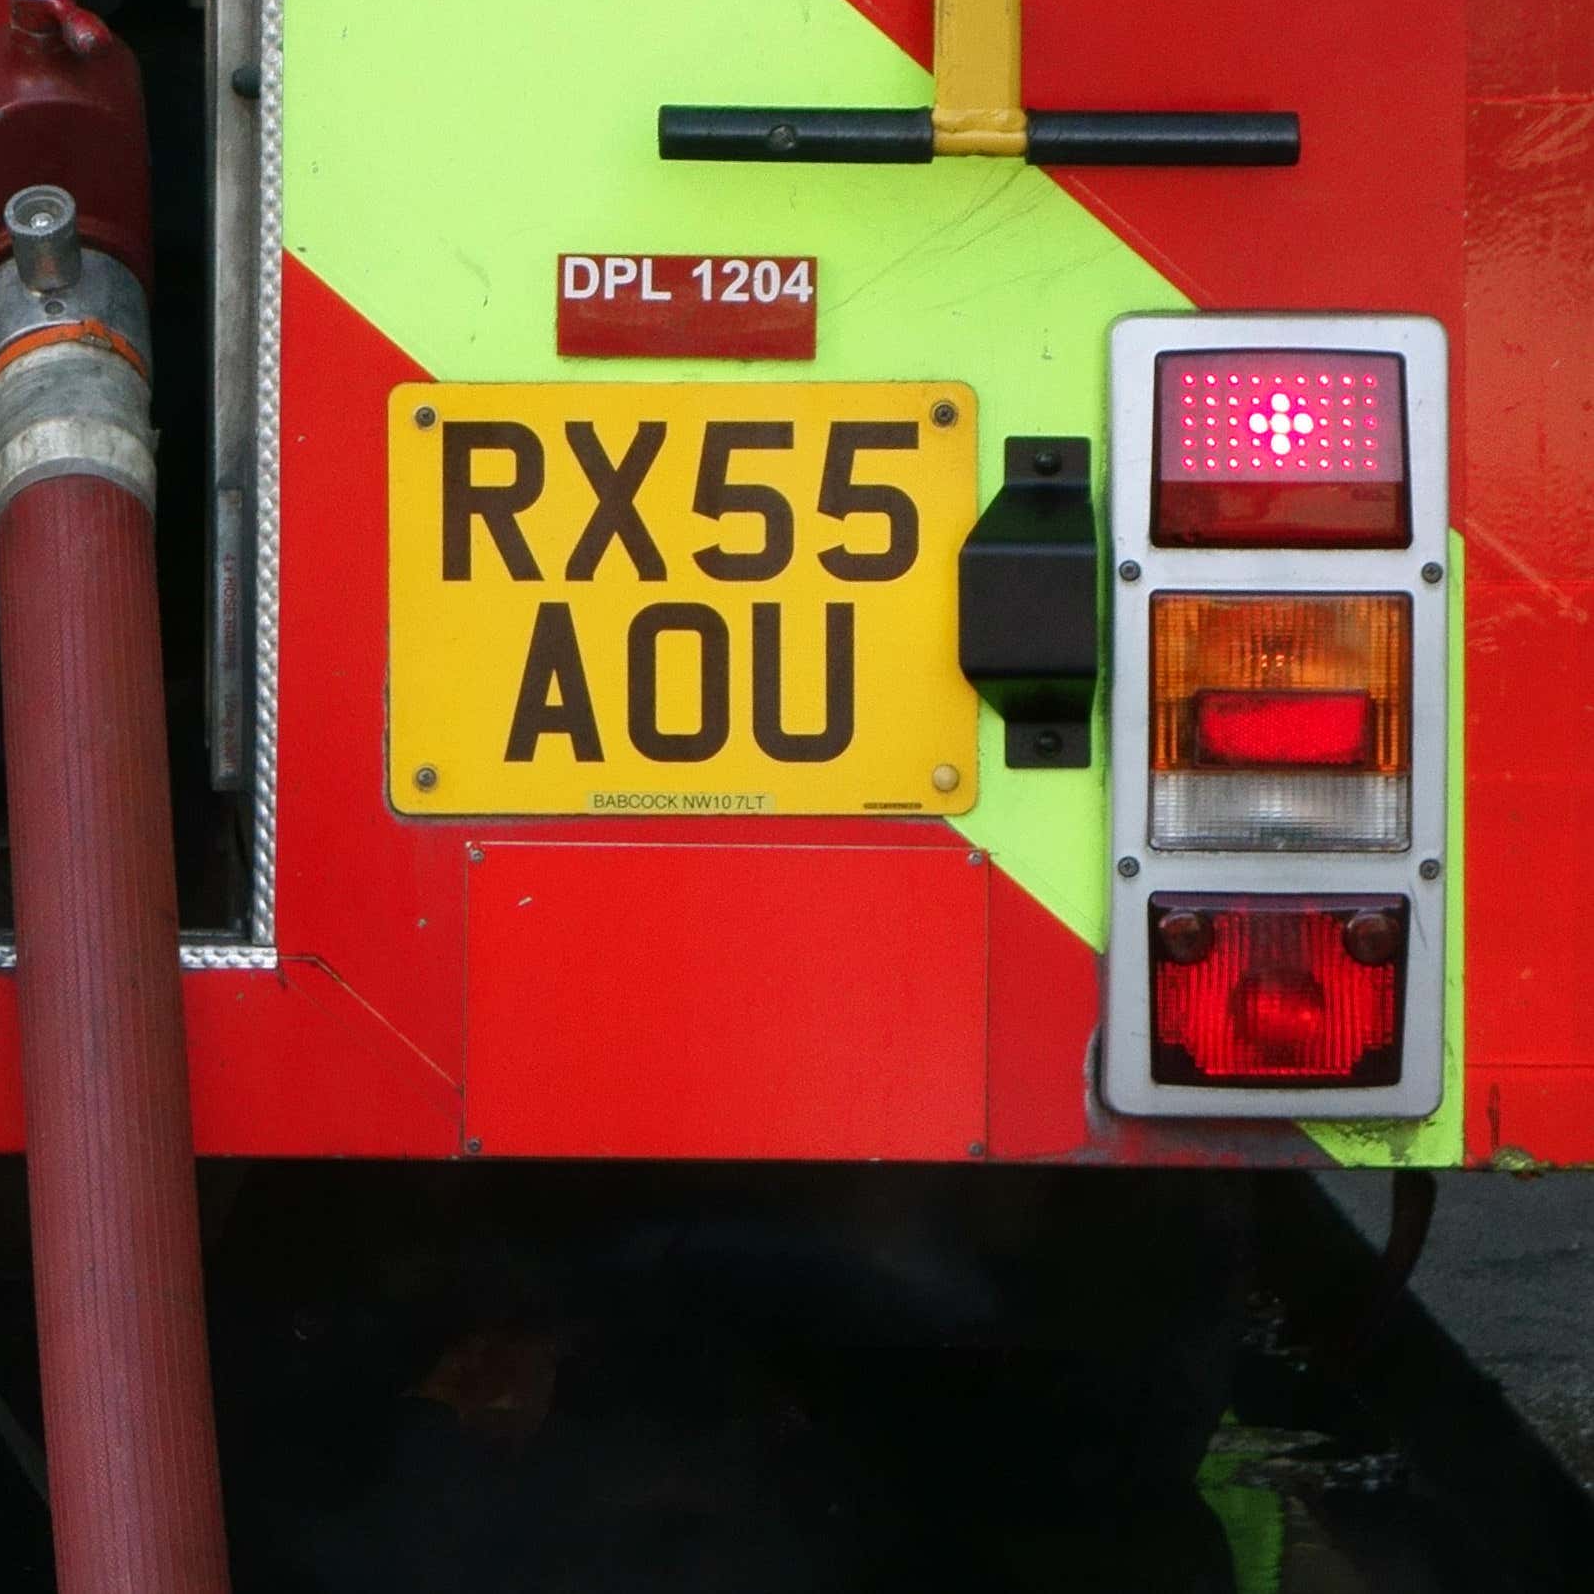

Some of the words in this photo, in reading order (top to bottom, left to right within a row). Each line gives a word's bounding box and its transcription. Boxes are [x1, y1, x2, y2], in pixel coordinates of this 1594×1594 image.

[563, 256, 671, 301] DPL
[691, 258, 813, 303] 1204
[441, 420, 920, 582] RX55
[503, 602, 855, 763] AOU
[593, 794, 678, 809] BABCOCK
[683, 794, 732, 809] NW10
[737, 794, 766, 810] 7LT
